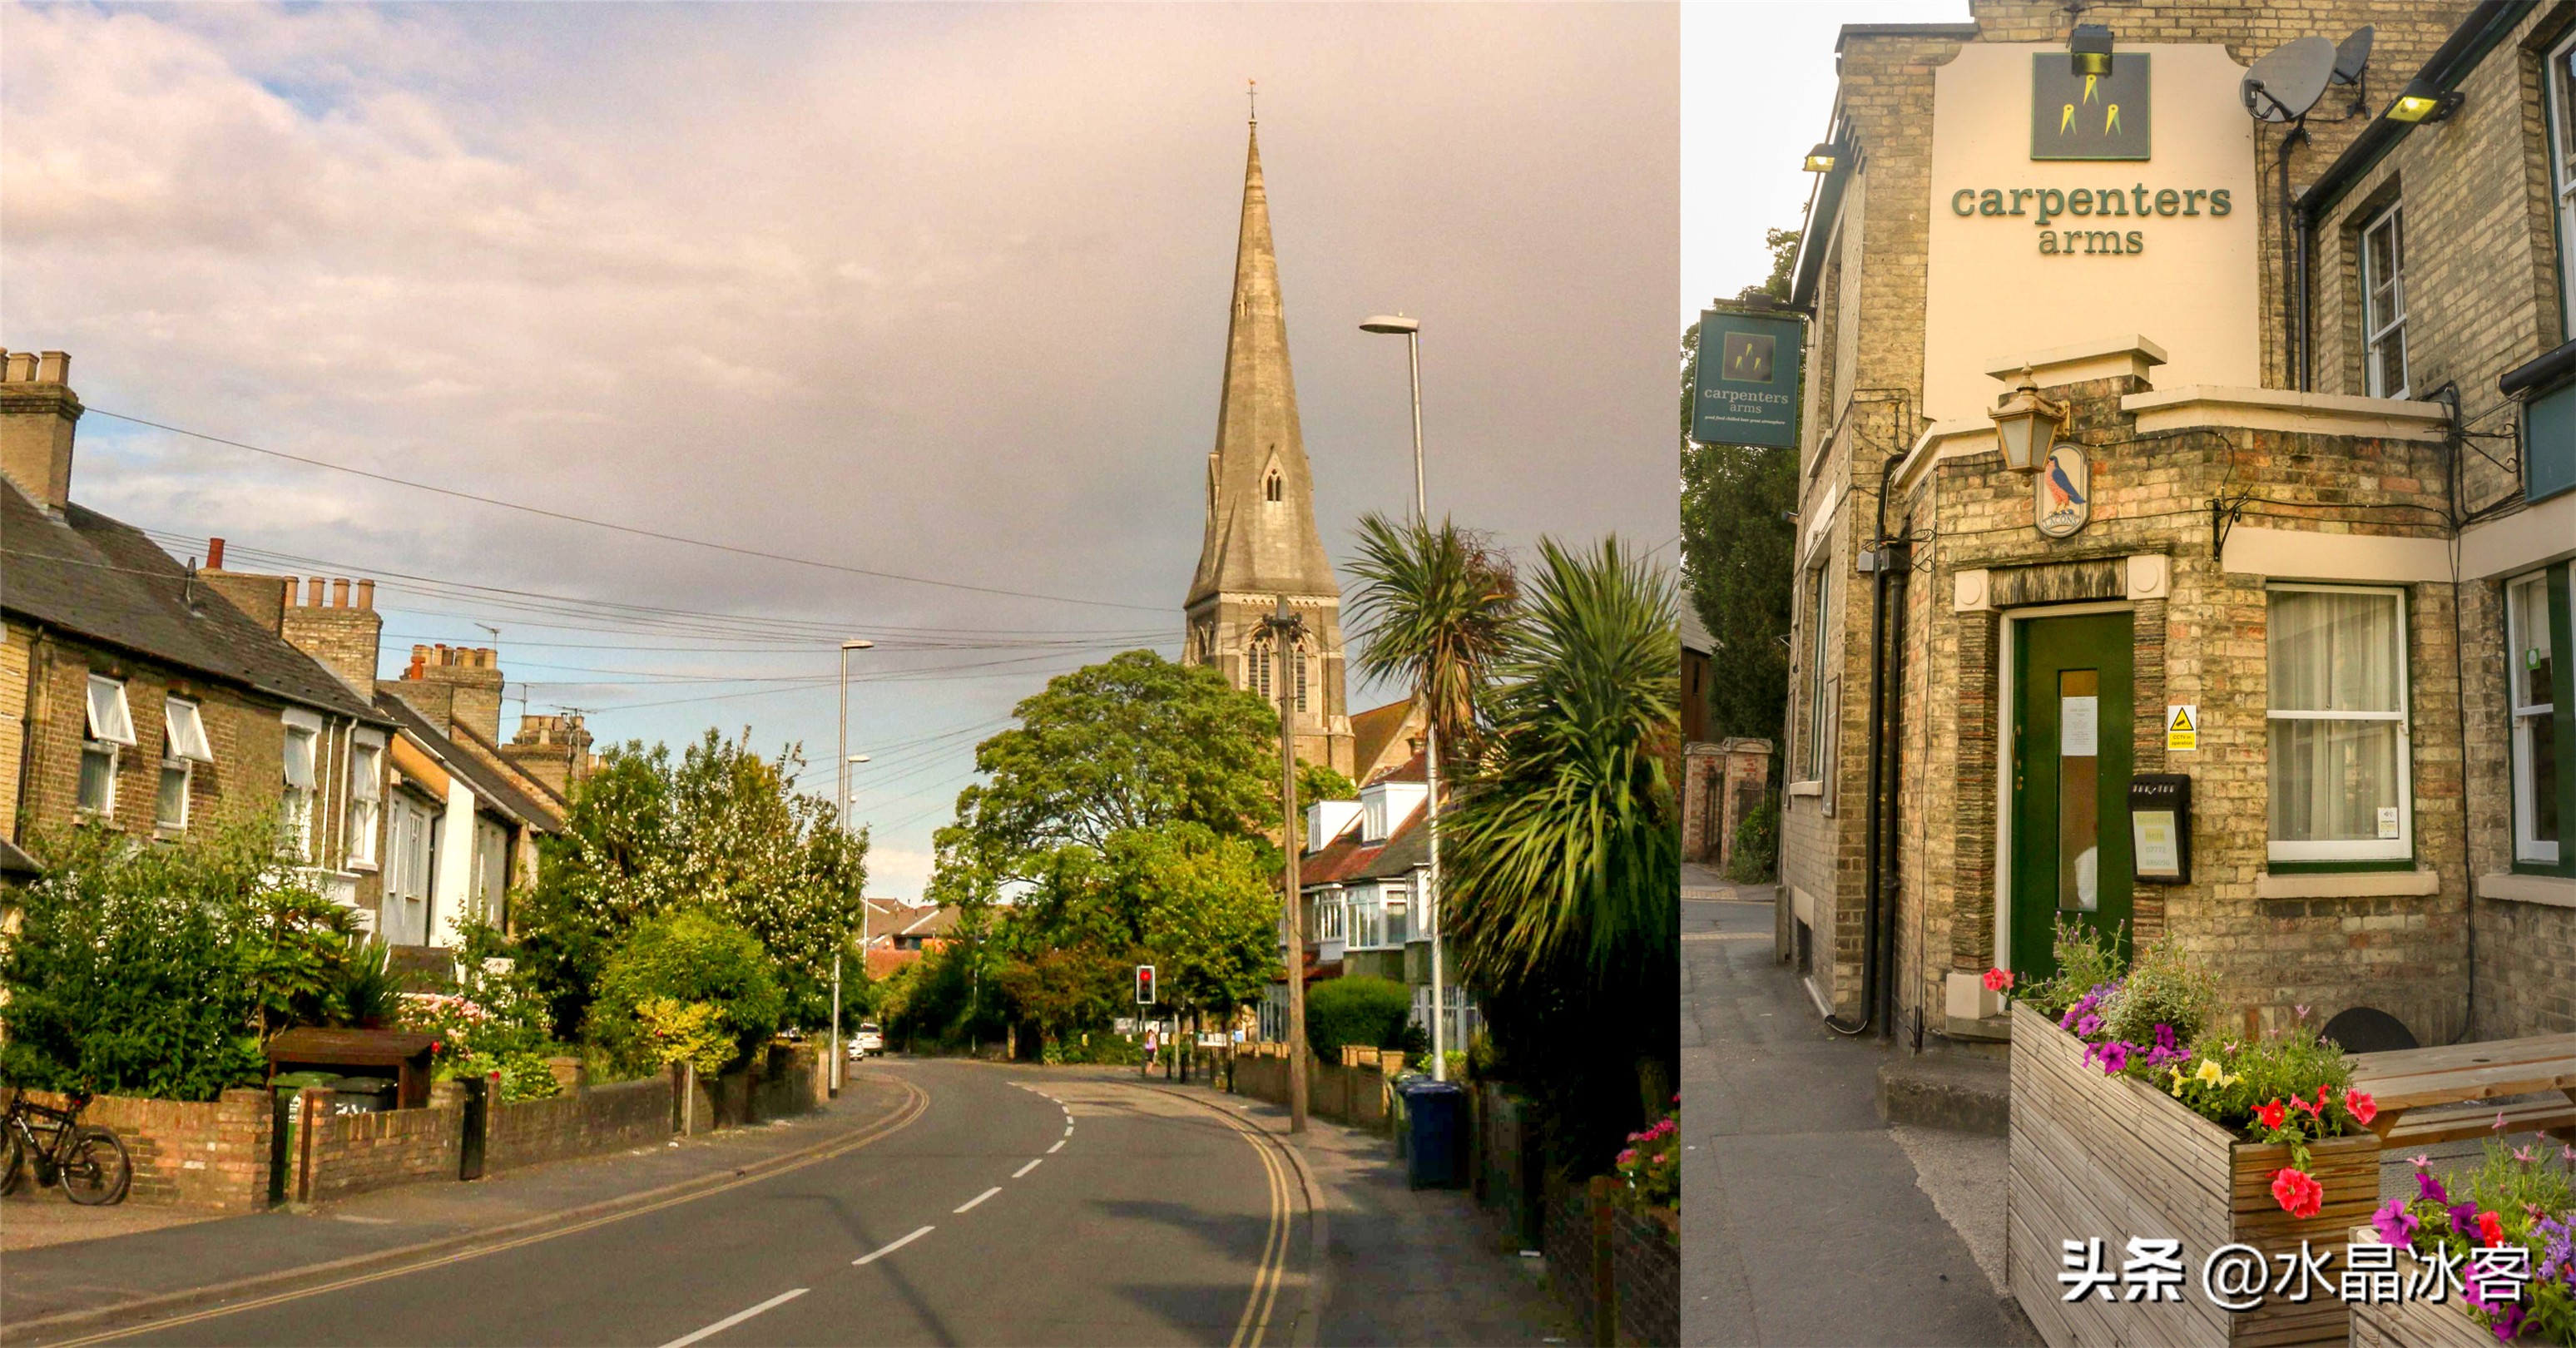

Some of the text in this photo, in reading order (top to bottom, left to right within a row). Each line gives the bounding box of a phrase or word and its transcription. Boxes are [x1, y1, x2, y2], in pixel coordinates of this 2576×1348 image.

[1952, 183, 2232, 225] carpenters
[2039, 229, 2144, 254] arms
[1704, 389, 1788, 404] carpenters
[1730, 404, 1762, 414] arms
[2043, 516, 2077, 528] LACONS
[2136, 816, 2171, 825] Advertise
[2145, 831, 2165, 840] Here
